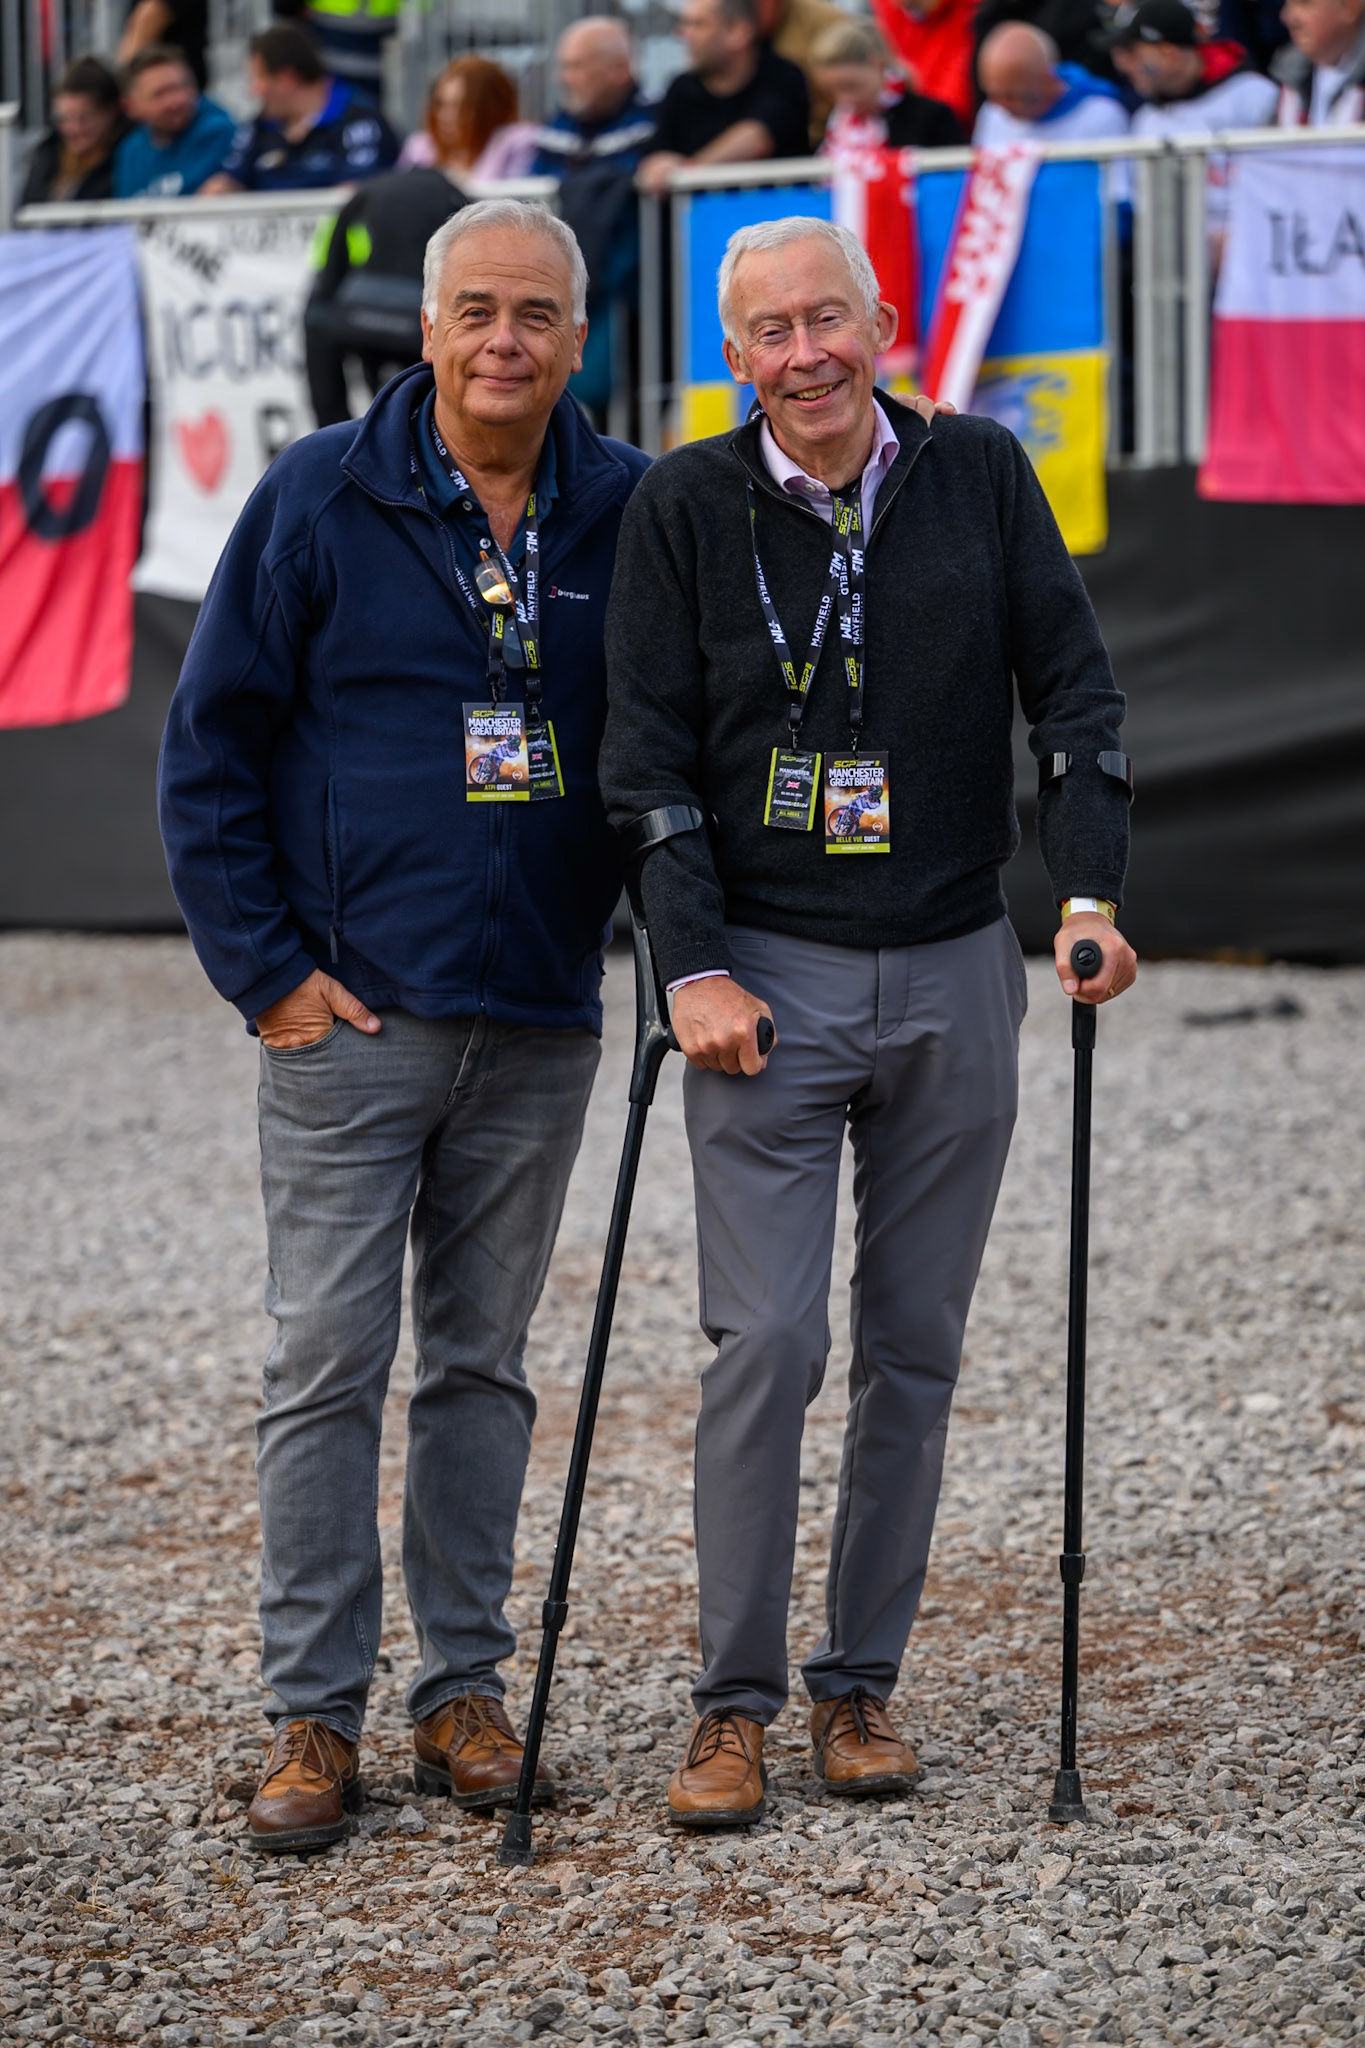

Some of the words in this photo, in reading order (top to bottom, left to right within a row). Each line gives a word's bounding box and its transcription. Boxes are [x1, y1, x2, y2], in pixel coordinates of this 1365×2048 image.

[431, 416, 447, 456] YFIELD
[450, 468, 470, 491] FIM
[526, 531, 538, 554] FIM
[494, 540, 518, 583] FIELD
[829, 551, 844, 578] FIM
[851, 549, 864, 575] FIM
[527, 570, 535, 620] MAYFIELD
[515, 600, 528, 624] FIM
[811, 595, 830, 647] MAYFIELD
[852, 592, 860, 645] MAYFIELD
[768, 619, 786, 644] FIM
[840, 613, 852, 639] FIM
[784, 661, 797, 686] SGP
[799, 668, 810, 693] SGP
[468, 718, 521, 727] MANCHESTER
[472, 710, 495, 718] SGP
[470, 727, 493, 735] GREAT
[494, 727, 520, 735] BRITAIN
[779, 768, 810, 776] MANCHESTER
[829, 768, 885, 778] MANCHESTER
[834, 760, 857, 768] SGP
[830, 778, 853, 786] GREAT
[855, 777, 883, 786] BRITAIN
